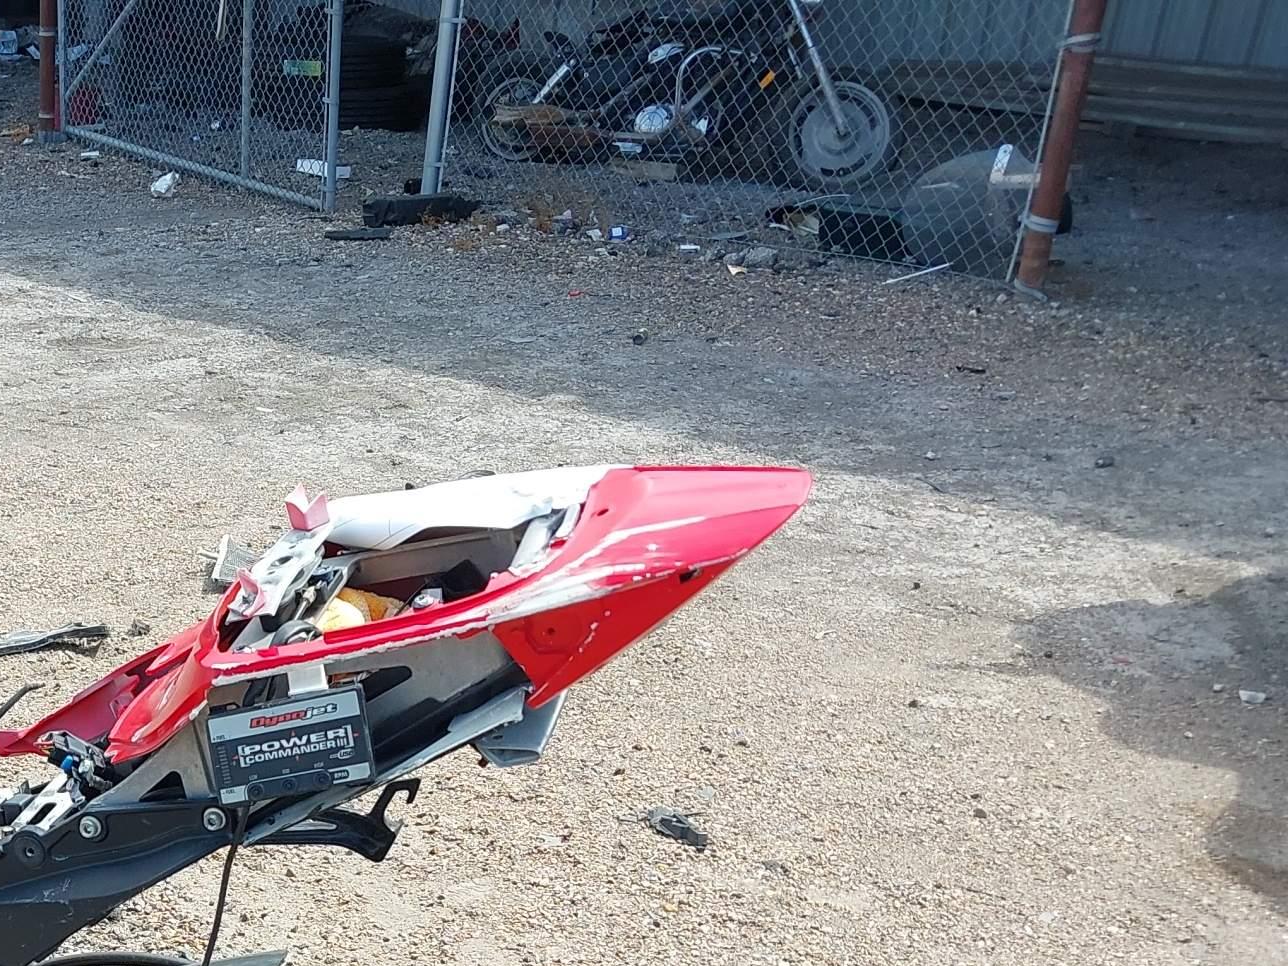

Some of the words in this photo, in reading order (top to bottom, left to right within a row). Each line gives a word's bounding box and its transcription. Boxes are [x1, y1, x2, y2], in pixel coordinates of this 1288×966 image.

[250, 703, 338, 729] Dynojet
[243, 728, 346, 755] POWER
[245, 740, 337, 764] COMMANDER
